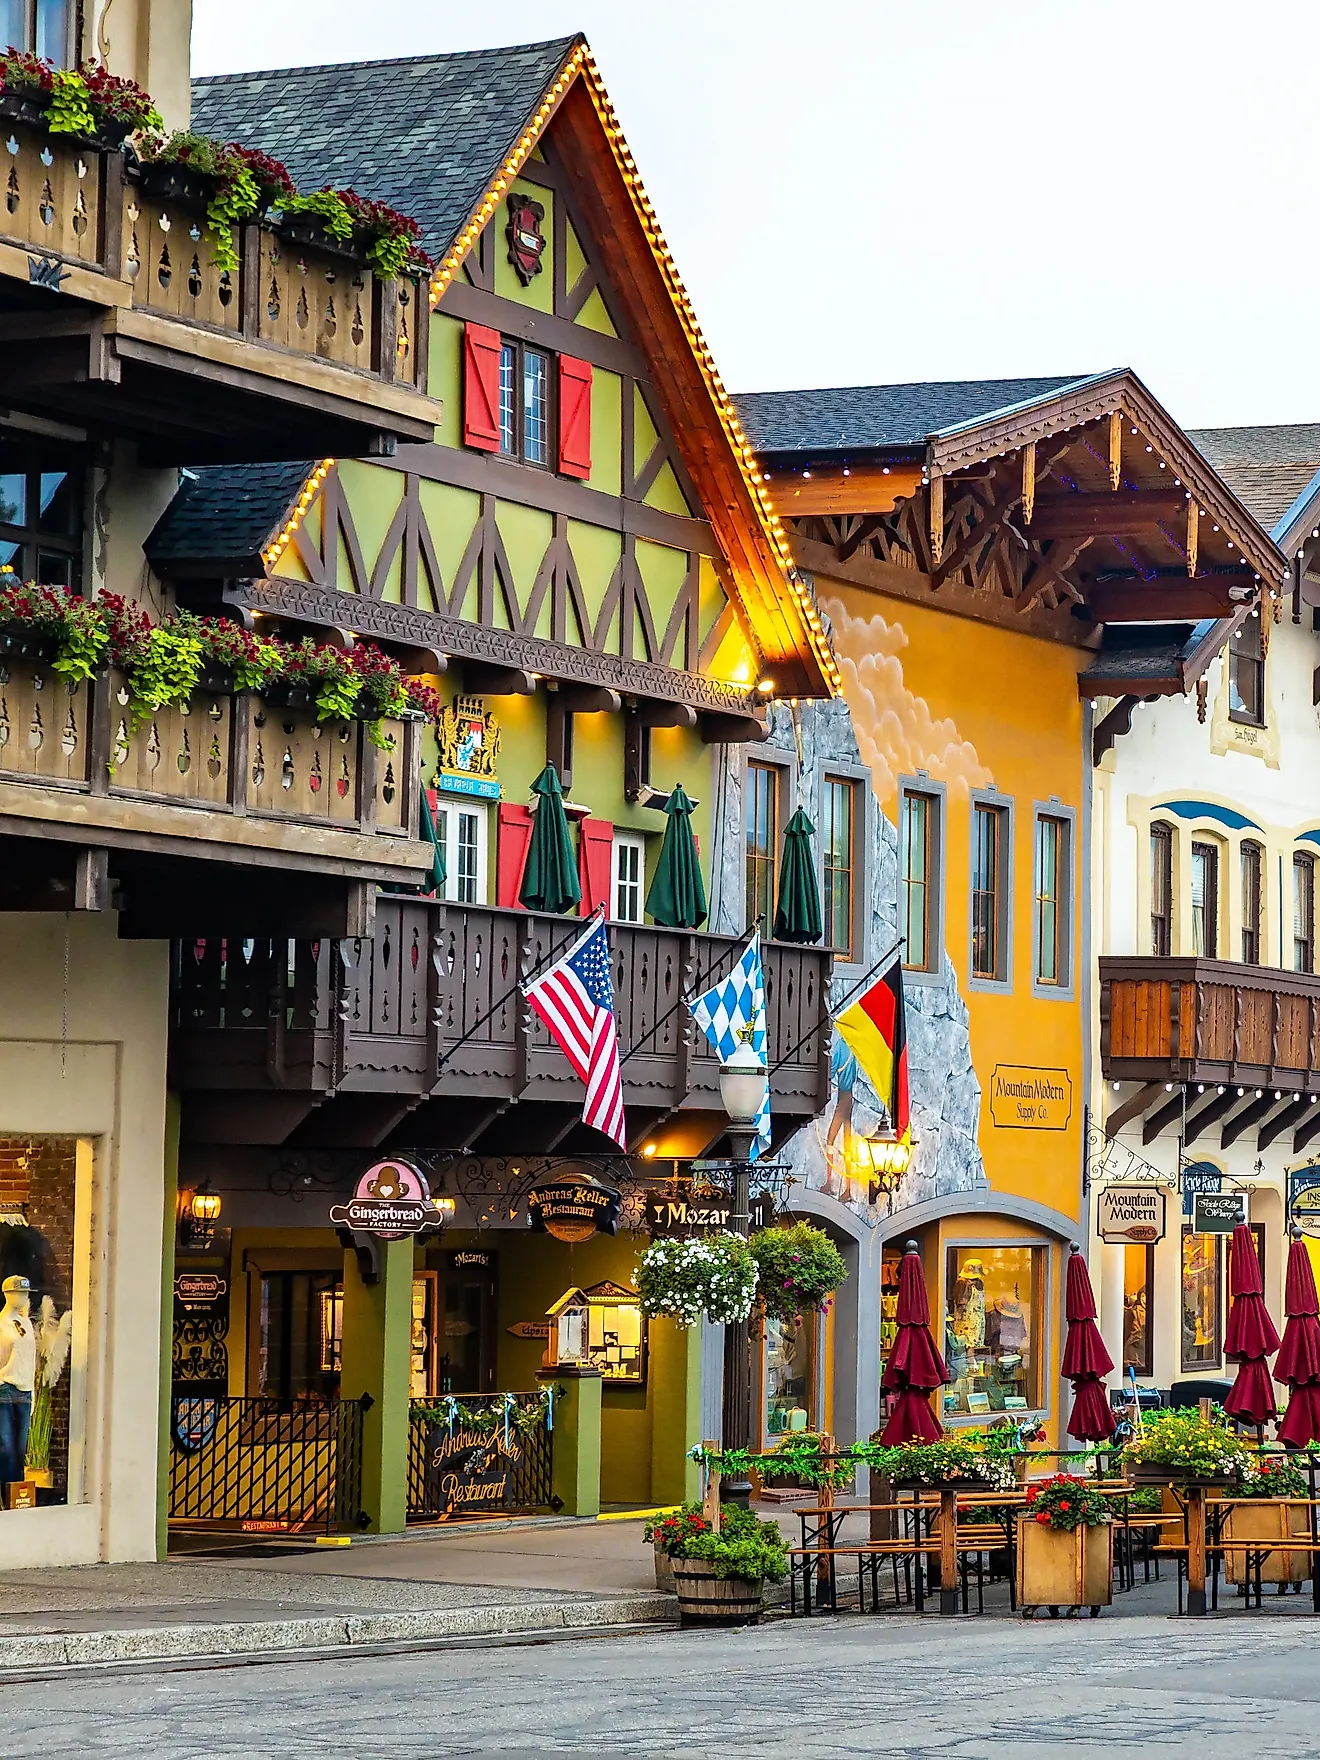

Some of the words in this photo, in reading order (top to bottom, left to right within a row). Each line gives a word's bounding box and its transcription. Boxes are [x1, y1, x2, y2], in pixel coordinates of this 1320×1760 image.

[1017, 1103, 1036, 1122] Supply
[573, 1186, 610, 1207] Keller
[1104, 1192, 1157, 1207] Mountain
[349, 1206, 423, 1222] Gingerbread
[540, 1203, 595, 1218] Restaurant
[667, 1203, 731, 1228] Mozar
[1109, 1206, 1157, 1220] Modern
[1129, 1228, 1147, 1237] Supply
[180, 1280, 217, 1293] Gingerbread
[441, 1473, 507, 1503] Restaurant
